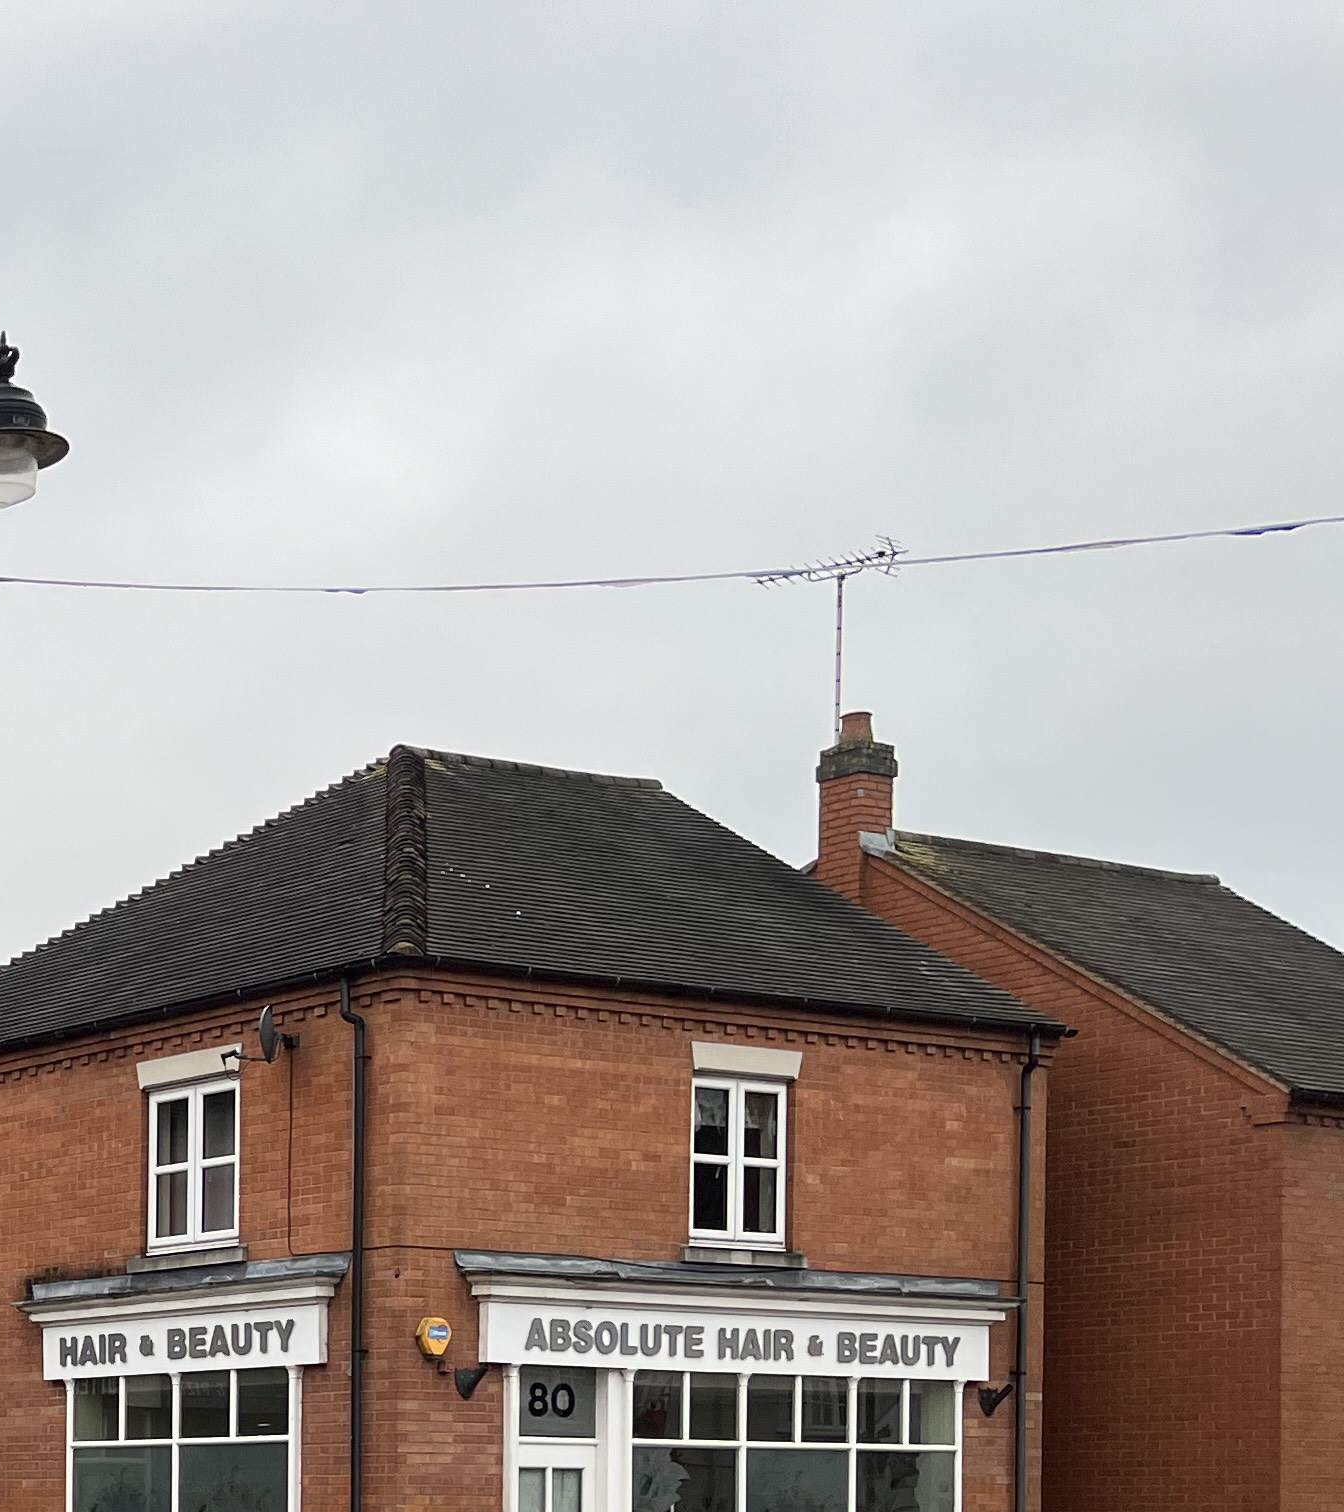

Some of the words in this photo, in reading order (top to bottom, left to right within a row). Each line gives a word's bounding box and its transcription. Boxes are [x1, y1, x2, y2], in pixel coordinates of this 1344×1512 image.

[59, 1333, 127, 1367] HAIR
[139, 1335, 154, 1357] &
[167, 1319, 294, 1360] BEAUTY
[525, 1318, 705, 1359] ABSOLUTE
[717, 1327, 795, 1362] HAIR
[808, 1335, 824, 1356] &
[837, 1331, 961, 1367] BEAUTY
[528, 1382, 576, 1418] 80
